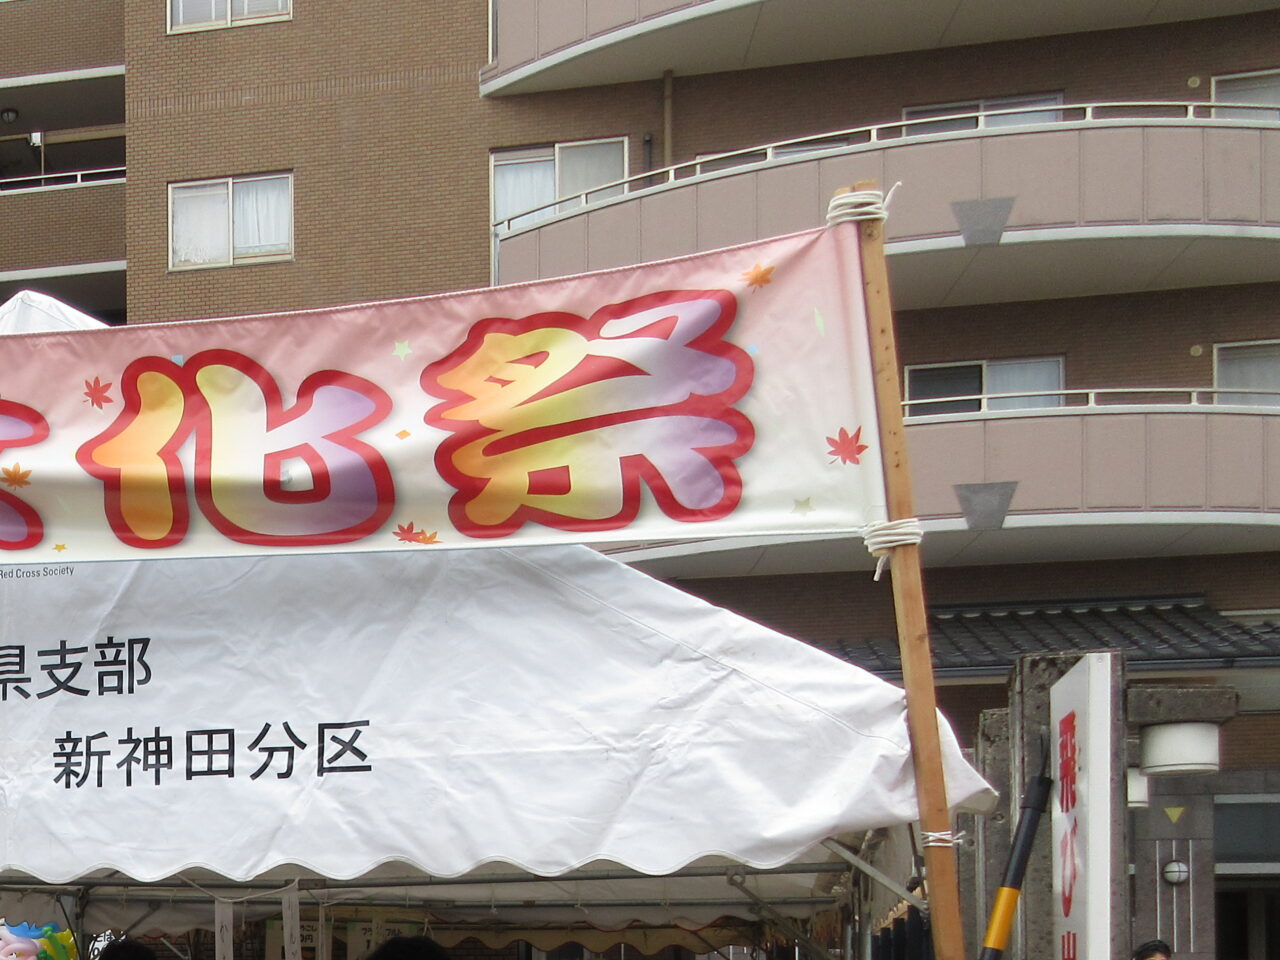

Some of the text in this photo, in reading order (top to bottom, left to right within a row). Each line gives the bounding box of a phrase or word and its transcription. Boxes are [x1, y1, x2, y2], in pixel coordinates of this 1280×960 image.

[16, 568, 41, 579] Cross
[43, 565, 75, 577] Society
[52, 719, 373, 790] 新神田分区
